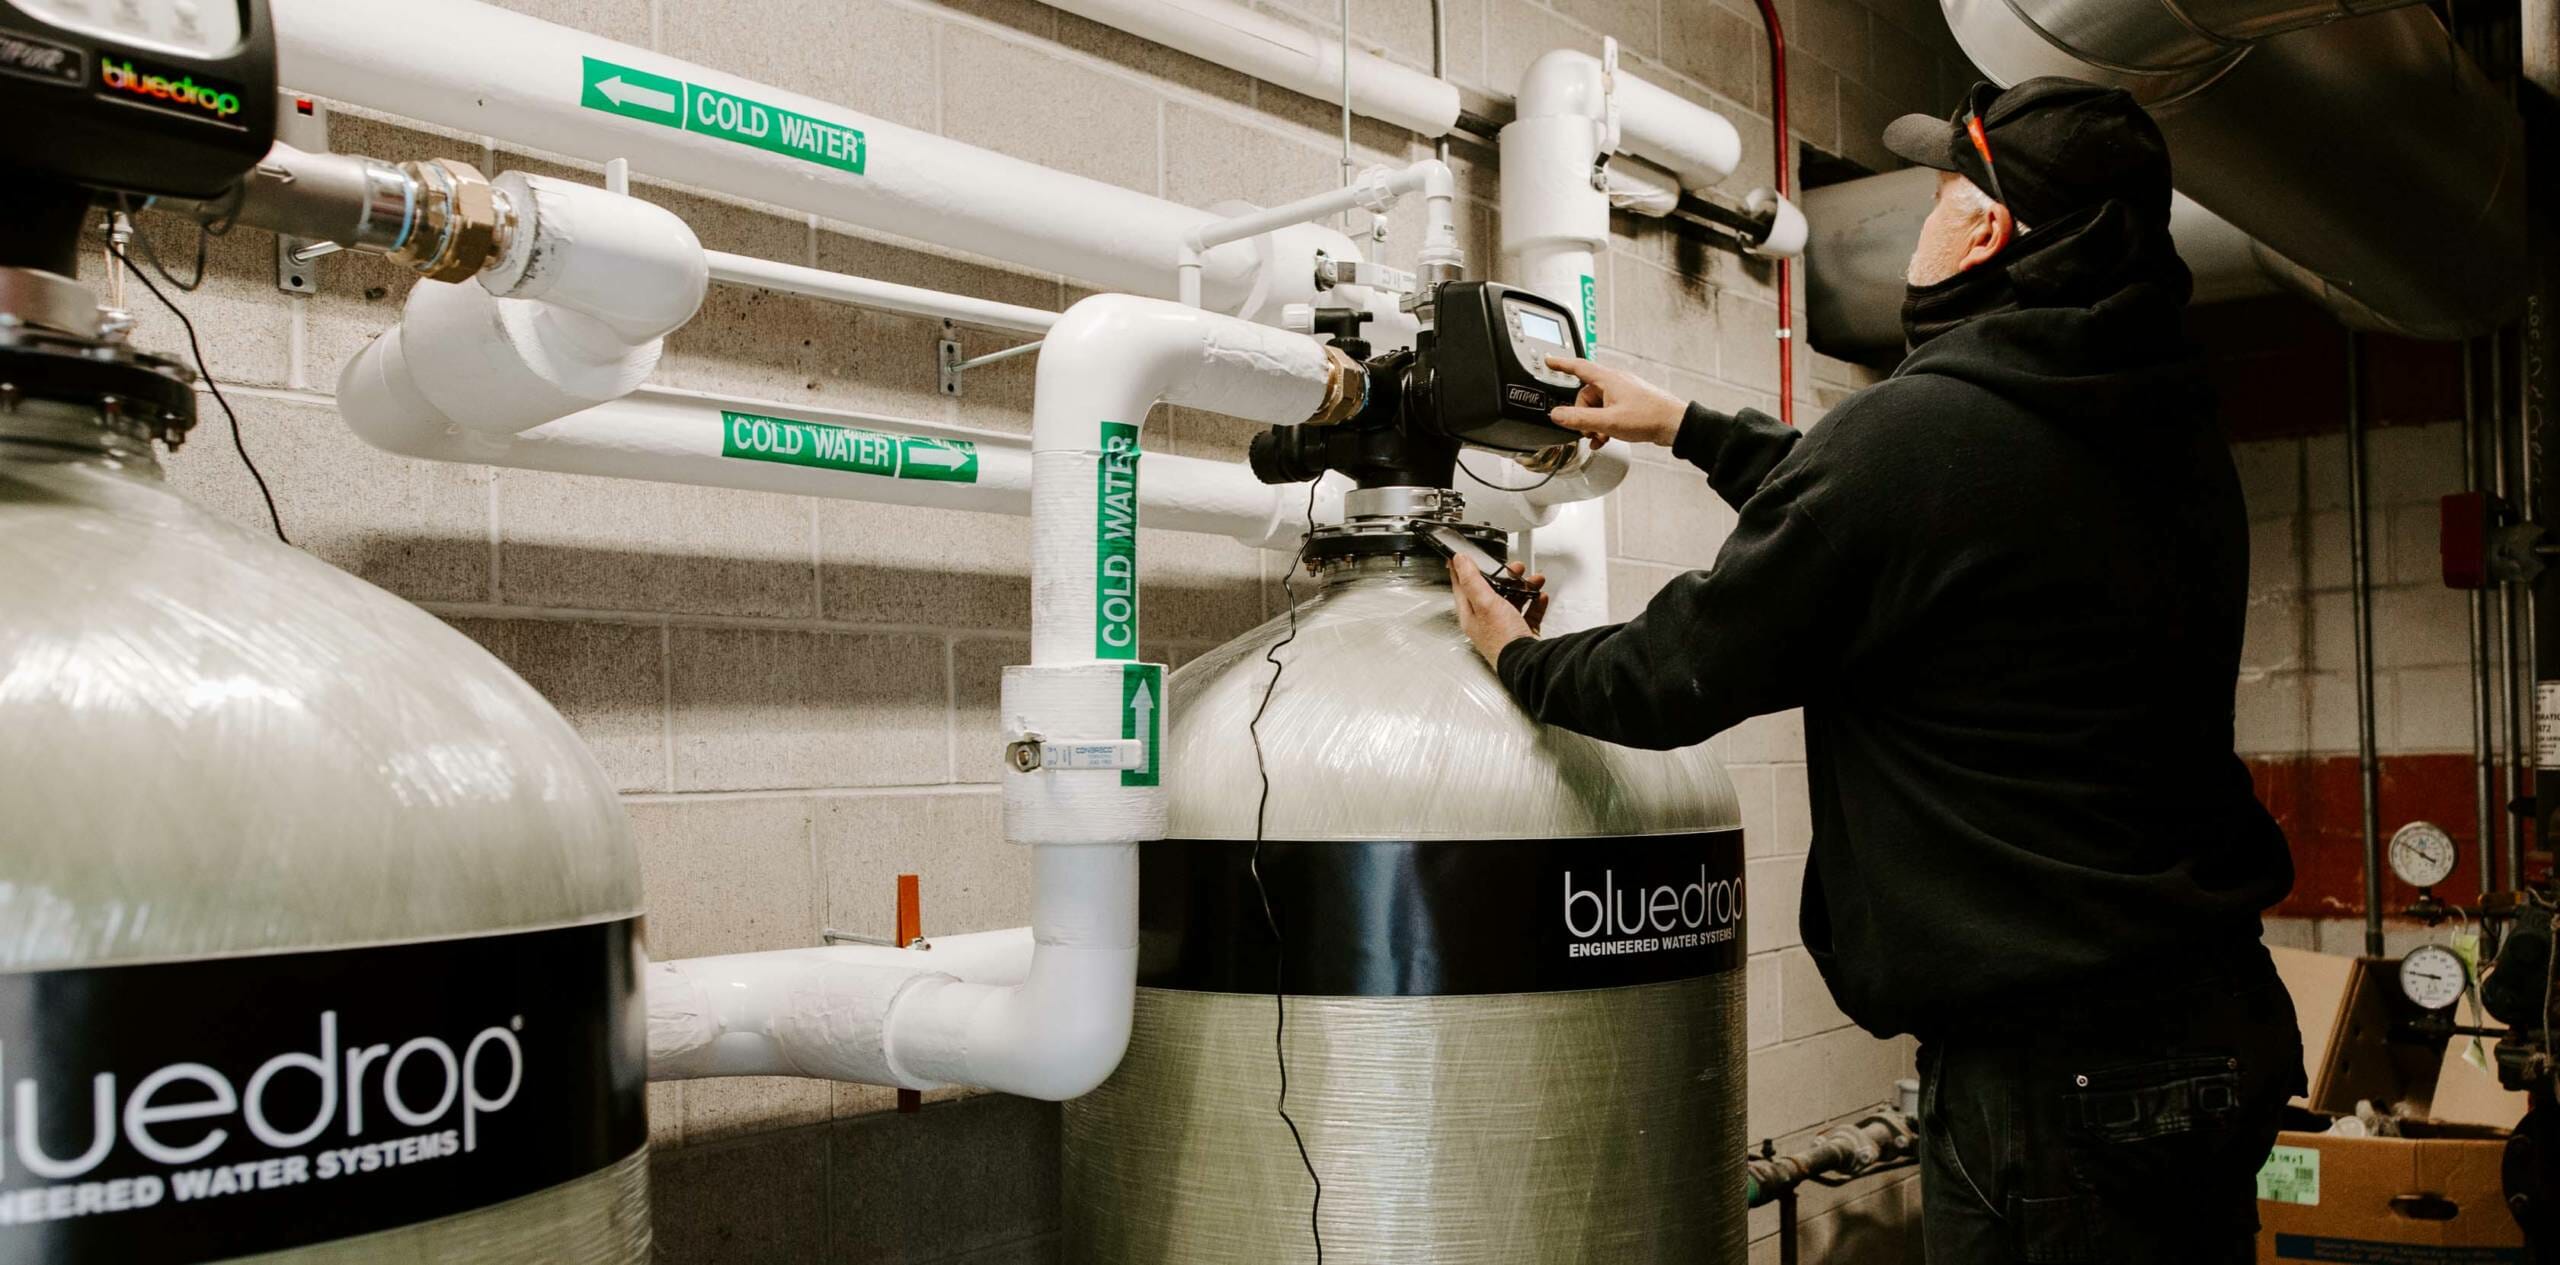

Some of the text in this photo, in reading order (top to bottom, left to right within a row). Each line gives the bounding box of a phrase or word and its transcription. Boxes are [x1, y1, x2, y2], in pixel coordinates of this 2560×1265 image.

[101, 55, 240, 118] bluedrop
[697, 91, 858, 163] COLD WATER
[733, 417, 889, 467] COLD WATER
[1102, 435, 1133, 648] COLD WATER
[1564, 863, 1744, 939] bluedrop
[1569, 927, 1732, 958] ENGINEERED WATER SYSTEMS
[0, 1010, 523, 1179] uedrop
[172, 1155, 309, 1202] WATER
[316, 1129, 459, 1180] SYSTEMS
